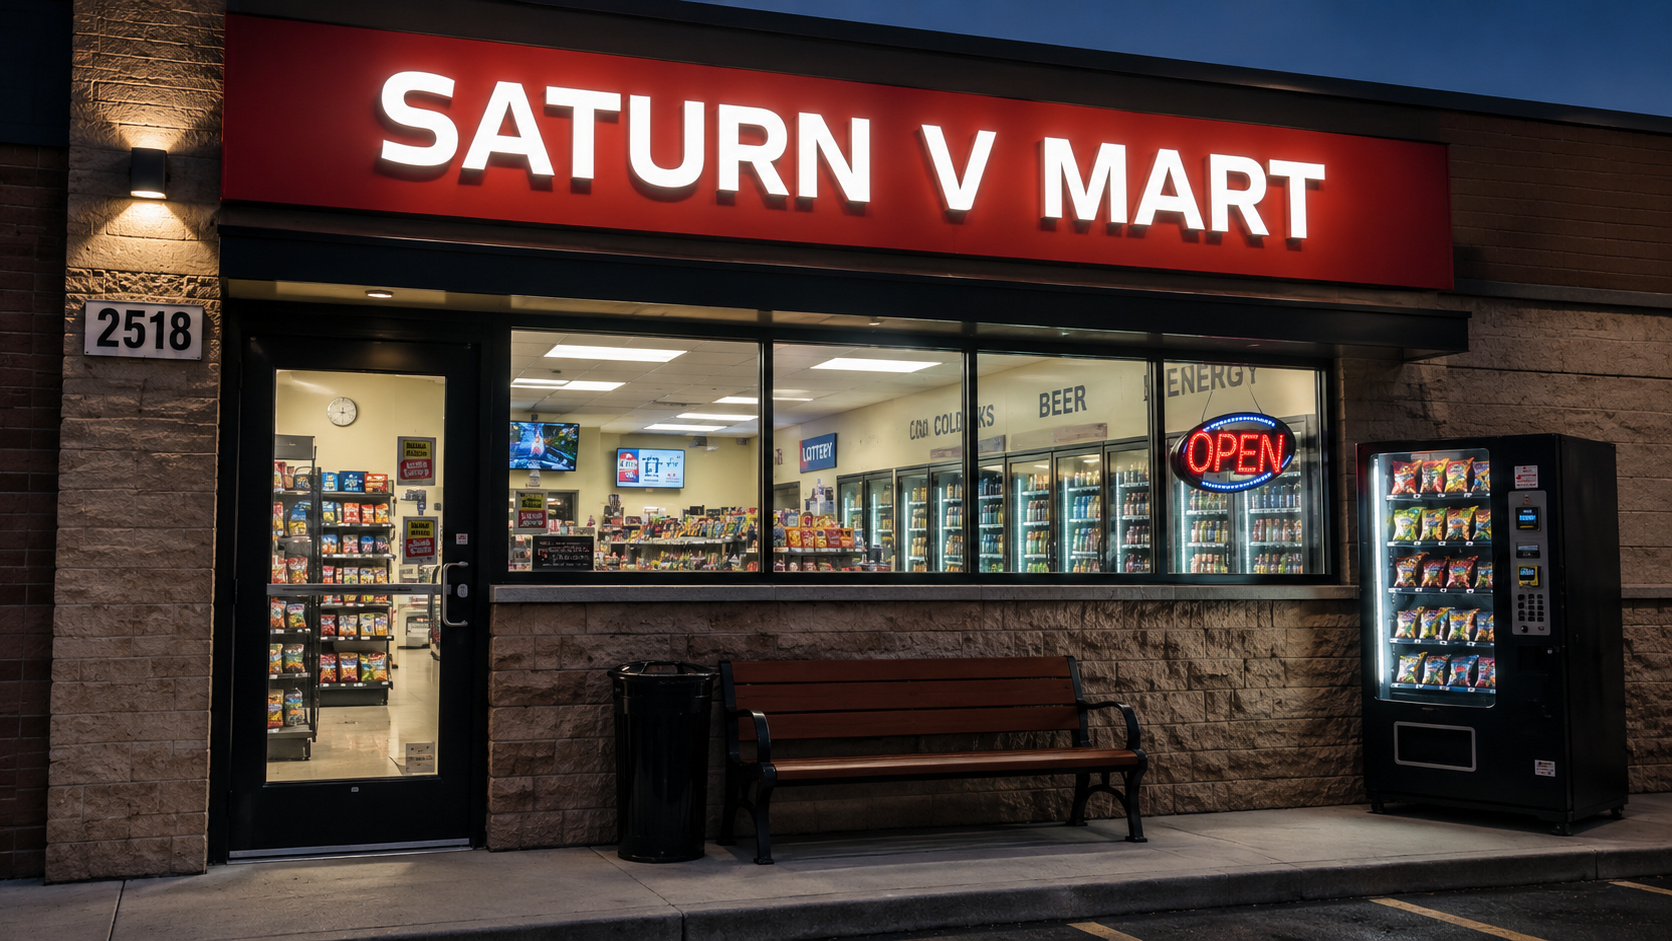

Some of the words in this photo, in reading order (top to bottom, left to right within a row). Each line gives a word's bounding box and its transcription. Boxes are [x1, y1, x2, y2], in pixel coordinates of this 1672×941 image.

[380, 70, 872, 204] SATURN
[919, 123, 998, 213] V
[1038, 136, 1327, 241] MART
[96, 307, 192, 351] 2518
[1038, 384, 1088, 418] BEER
[1166, 365, 1257, 398] ENERGY
[1187, 431, 1286, 474] OPEN
